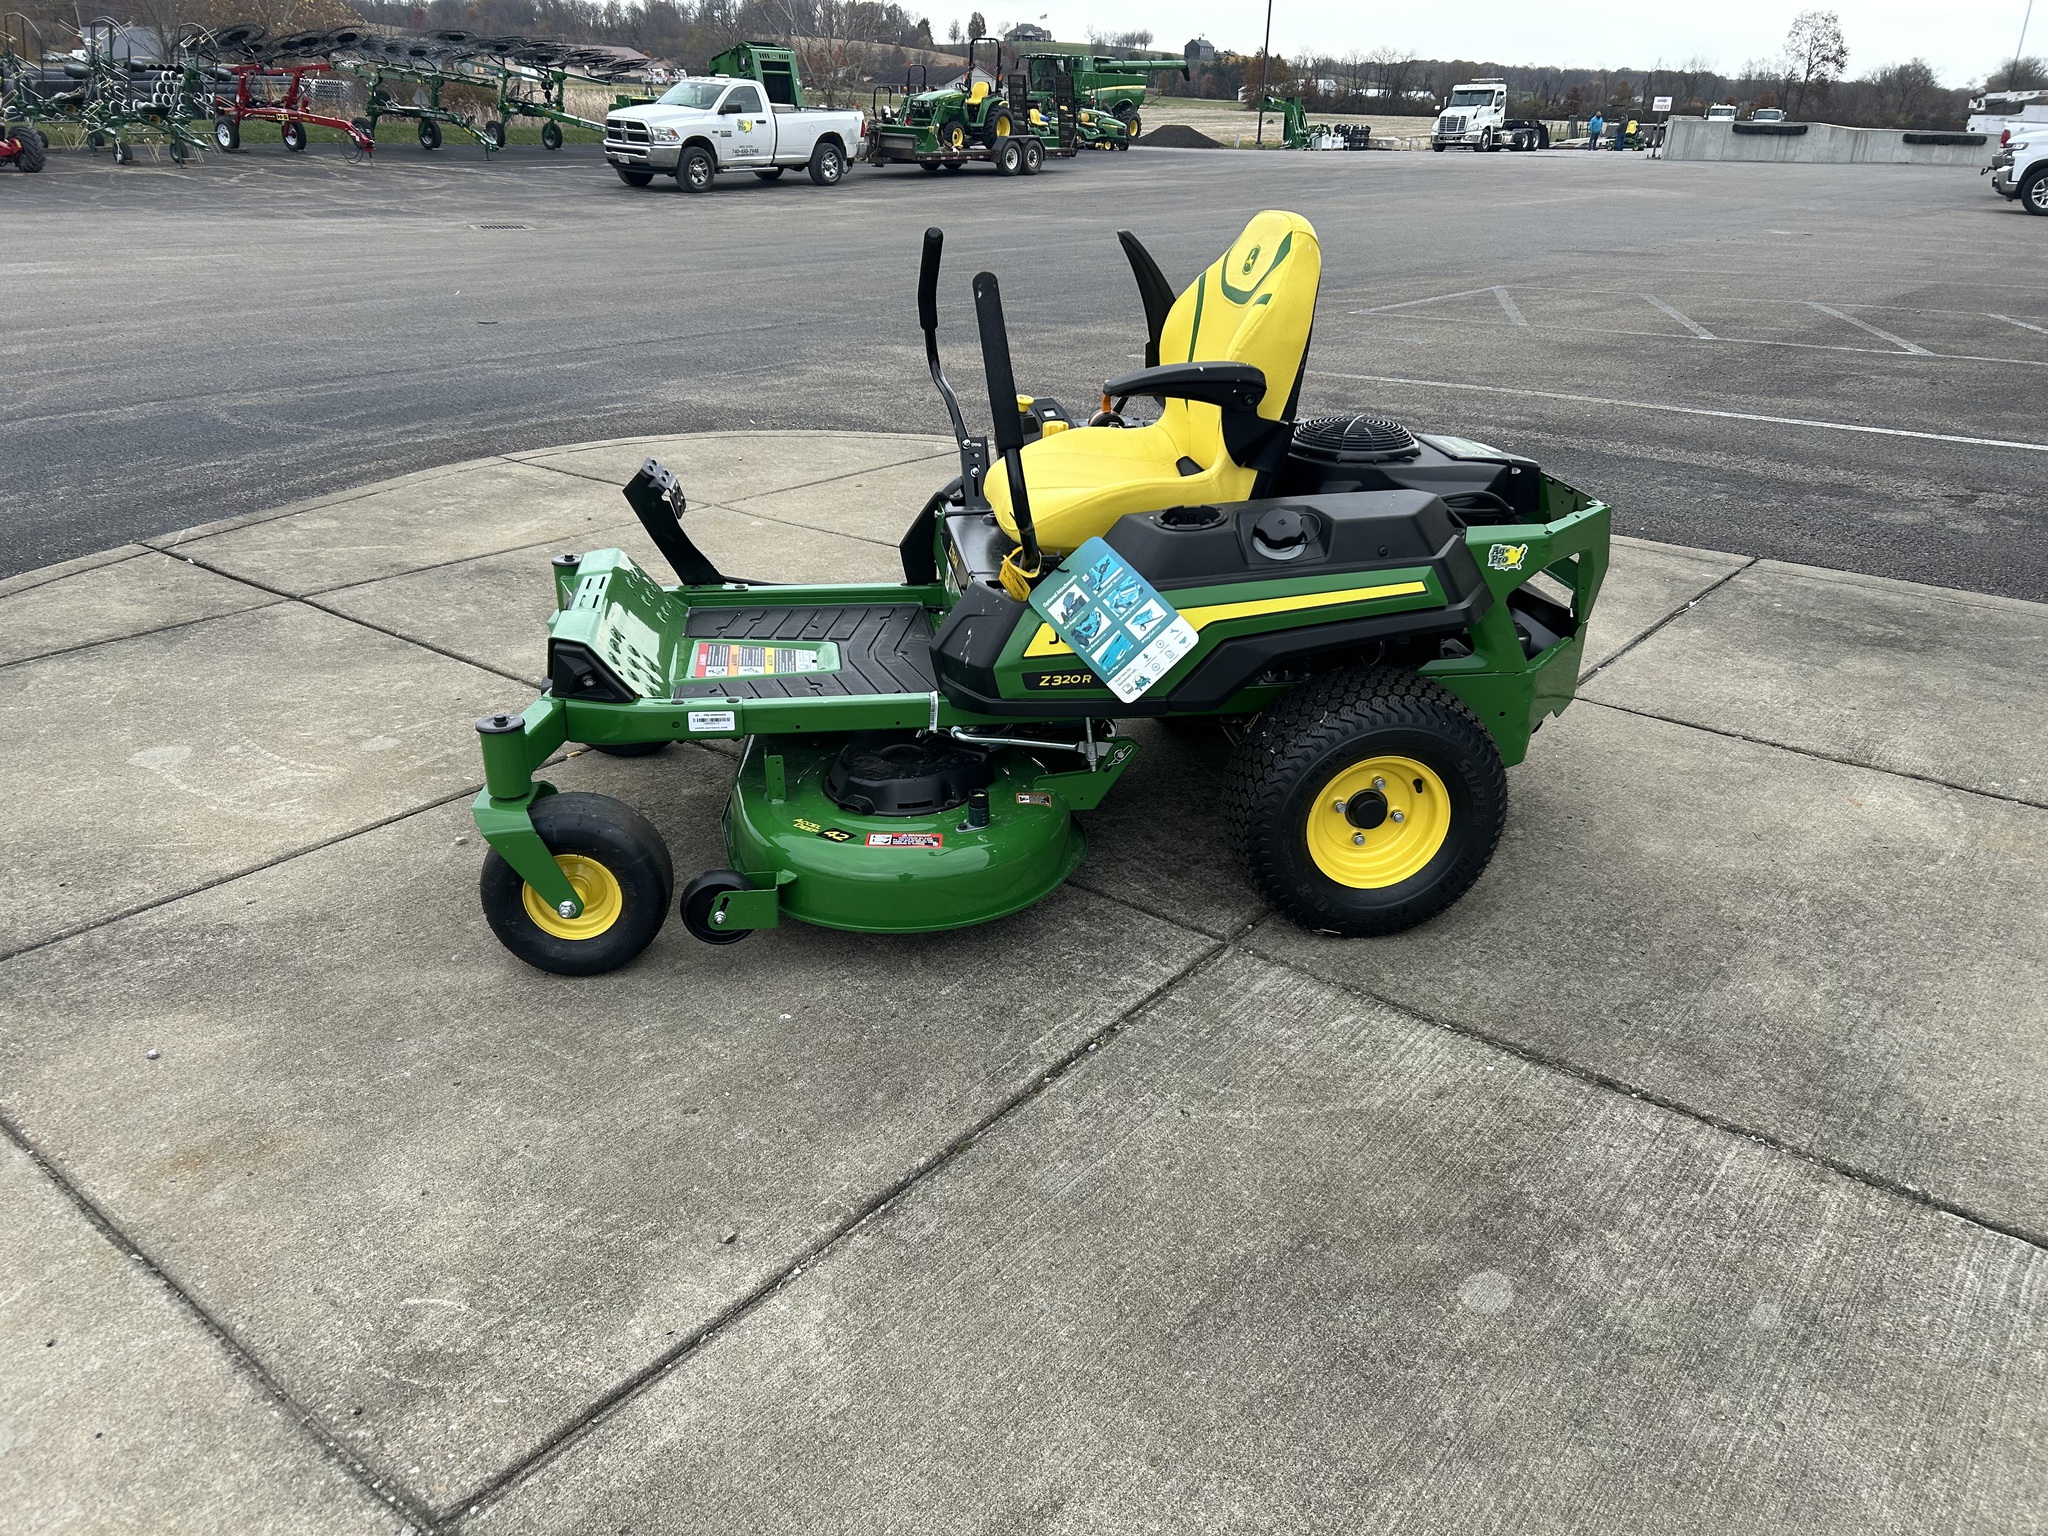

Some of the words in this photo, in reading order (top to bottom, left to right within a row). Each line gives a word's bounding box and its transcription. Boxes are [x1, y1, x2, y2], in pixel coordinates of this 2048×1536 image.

[1490, 555, 1509, 564] Pro
[1042, 592, 1058, 608] Optional
[824, 831, 850, 841] 42
